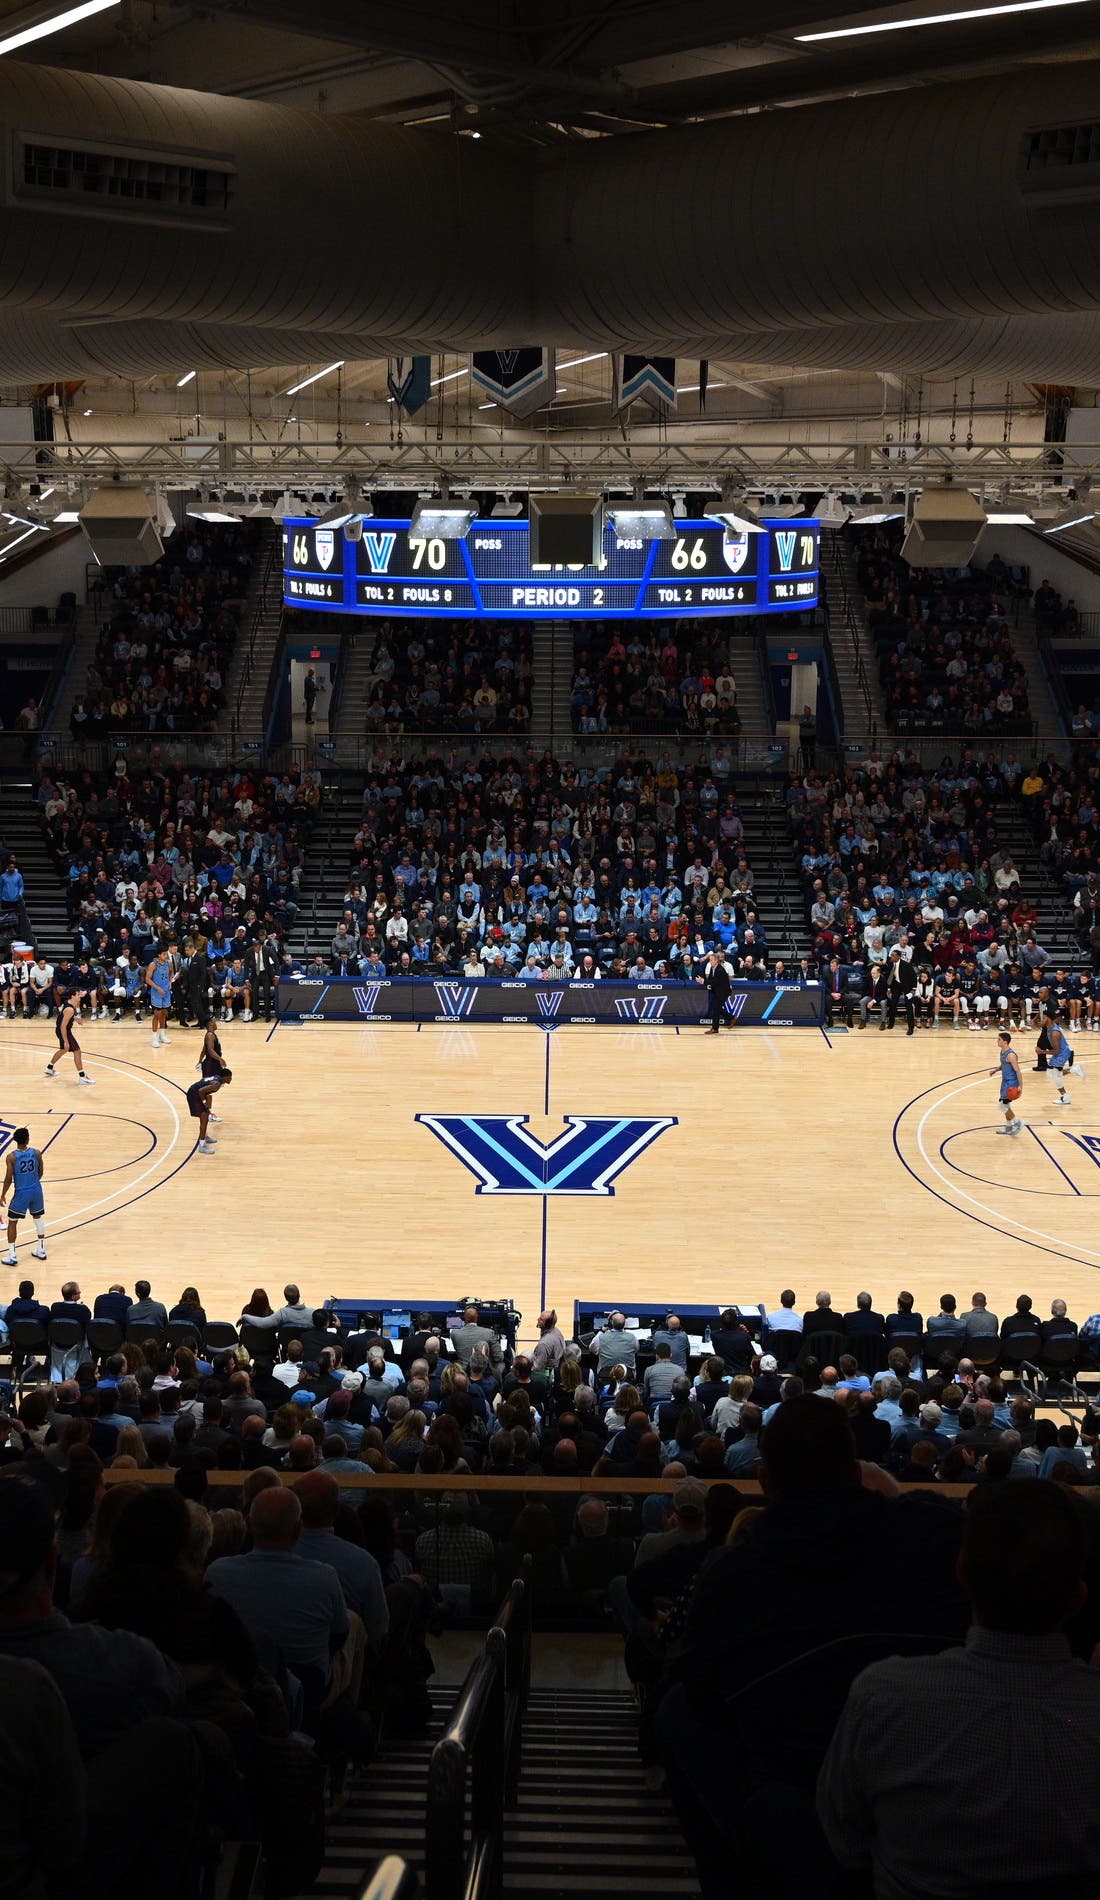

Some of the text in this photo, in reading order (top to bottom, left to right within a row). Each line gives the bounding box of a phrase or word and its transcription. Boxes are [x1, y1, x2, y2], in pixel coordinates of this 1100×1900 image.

[293, 535, 309, 565] 66
[474, 539, 502, 550] POSS
[616, 539, 643, 550] POSS
[801, 536, 814, 565] 70
[409, 539, 446, 570] 70
[671, 539, 707, 570] 66
[365, 587, 453, 602] TOL 2 FOULS 8
[512, 588, 604, 605] PERIOD 2
[658, 587, 744, 602] TOL 2 FOULS 6
[413, 1113, 679, 1197] V
[20, 1159, 34, 1174] 23
